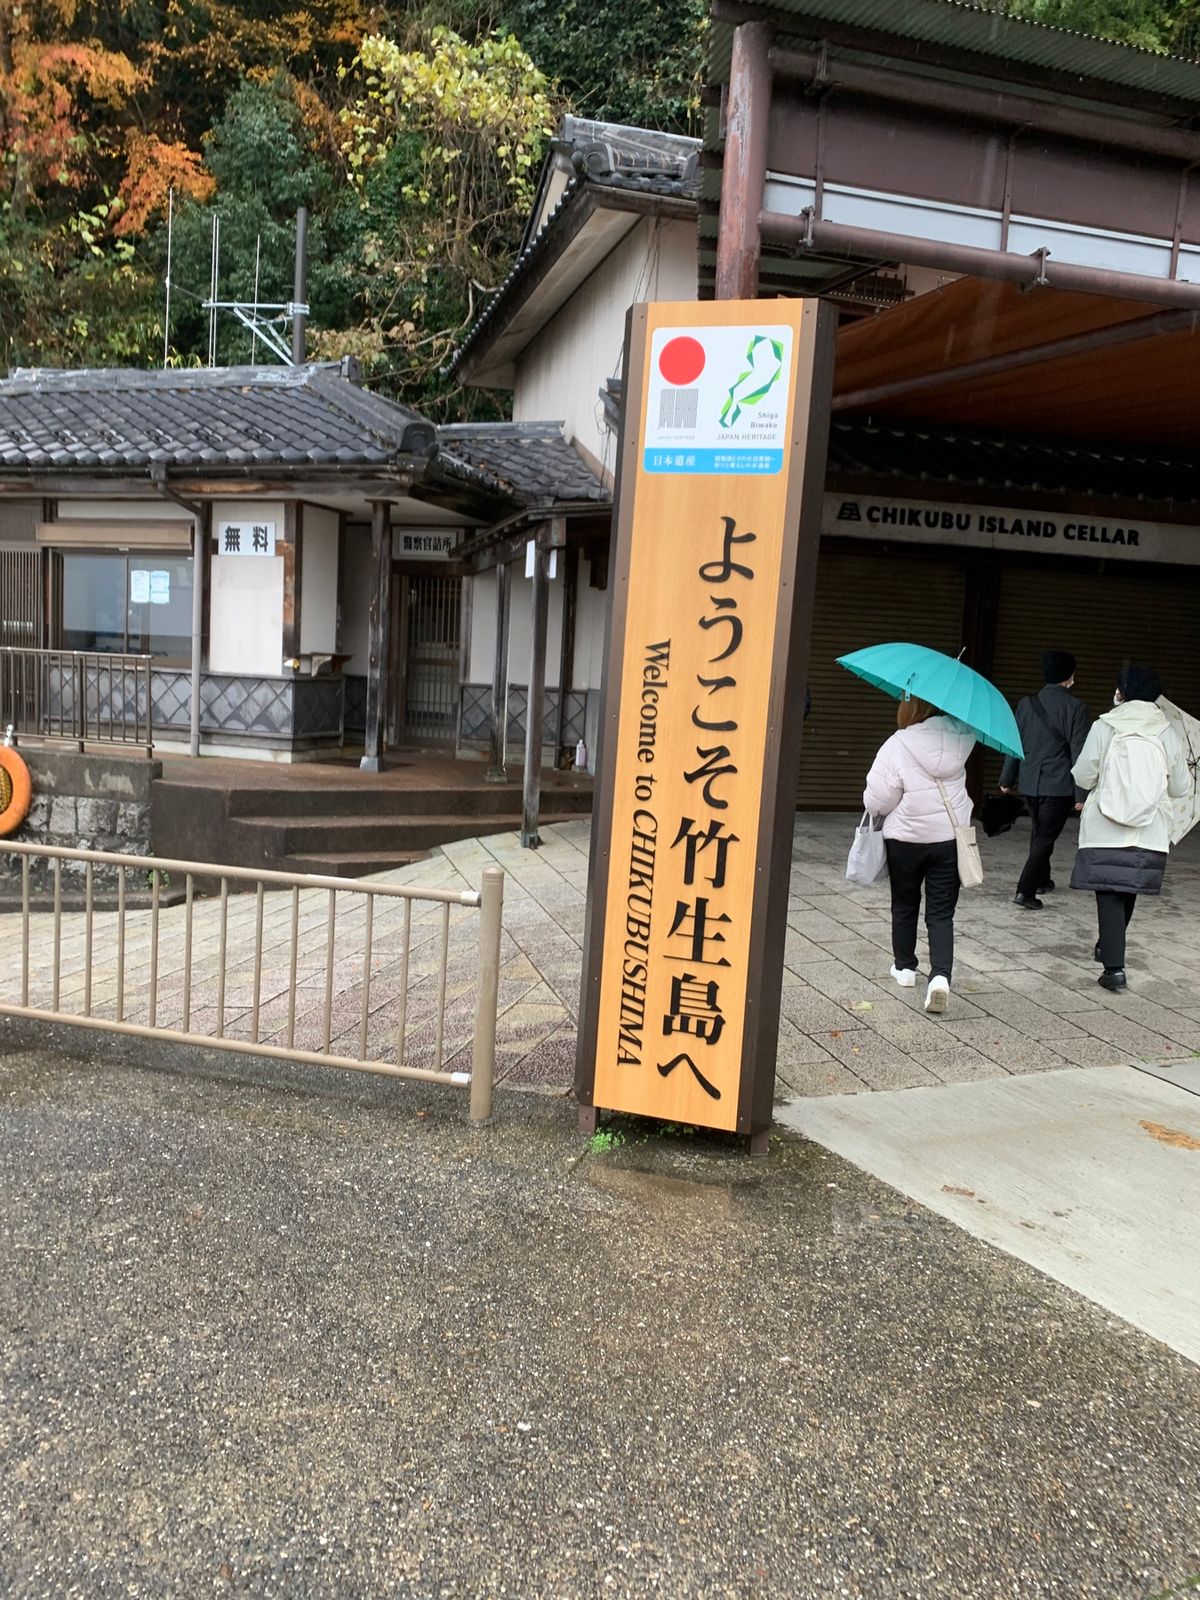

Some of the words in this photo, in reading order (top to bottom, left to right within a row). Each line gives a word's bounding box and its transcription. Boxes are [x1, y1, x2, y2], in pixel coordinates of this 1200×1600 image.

[750, 421, 778, 429] Biwako
[757, 411, 779, 420] Shiga
[741, 433, 777, 441] HERITAGE
[653, 455, 696, 467] 日本遺産
[224, 525, 269, 552] 無料
[866, 505, 971, 531] CHIKUBU
[978, 515, 1057, 539] ISLAND
[1063, 524, 1140, 547] CELLAR
[636, 638, 671, 764] Welcome
[634, 773, 658, 802] to
[656, 515, 757, 1101] ようこそ竹生島へ
[616, 808, 659, 1067] CHIKUBUSHIMA
